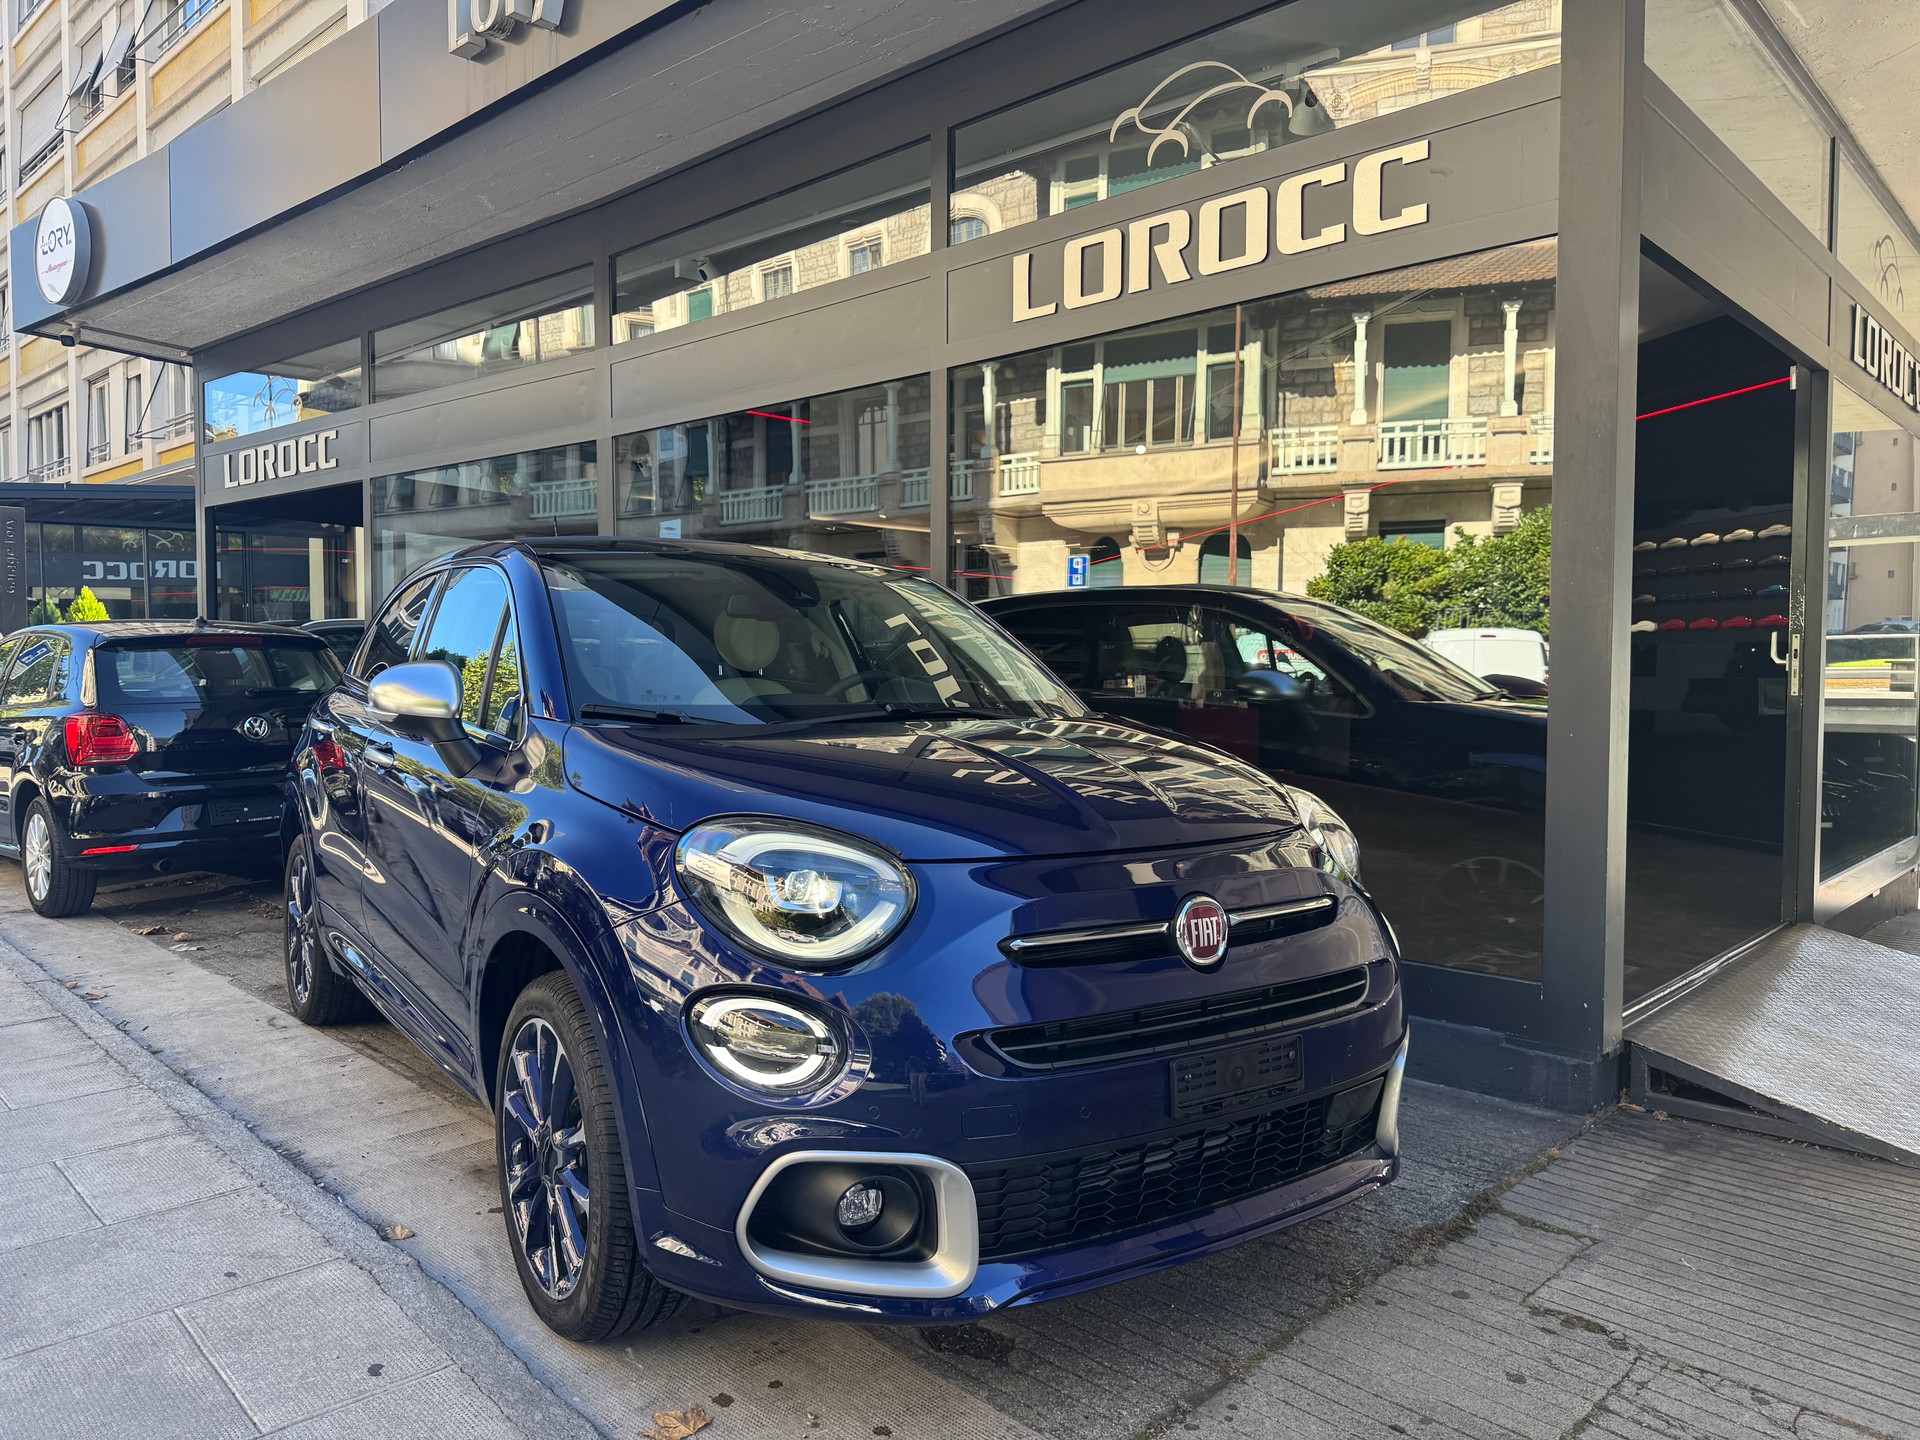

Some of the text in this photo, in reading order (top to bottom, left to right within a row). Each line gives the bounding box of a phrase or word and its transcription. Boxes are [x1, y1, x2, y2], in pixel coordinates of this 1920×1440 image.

[1012, 139, 1429, 323] LOROCC
[1854, 303, 1920, 411] LOROC
[223, 430, 337, 489] LOROCC
[1190, 916, 1219, 948] FIAT
